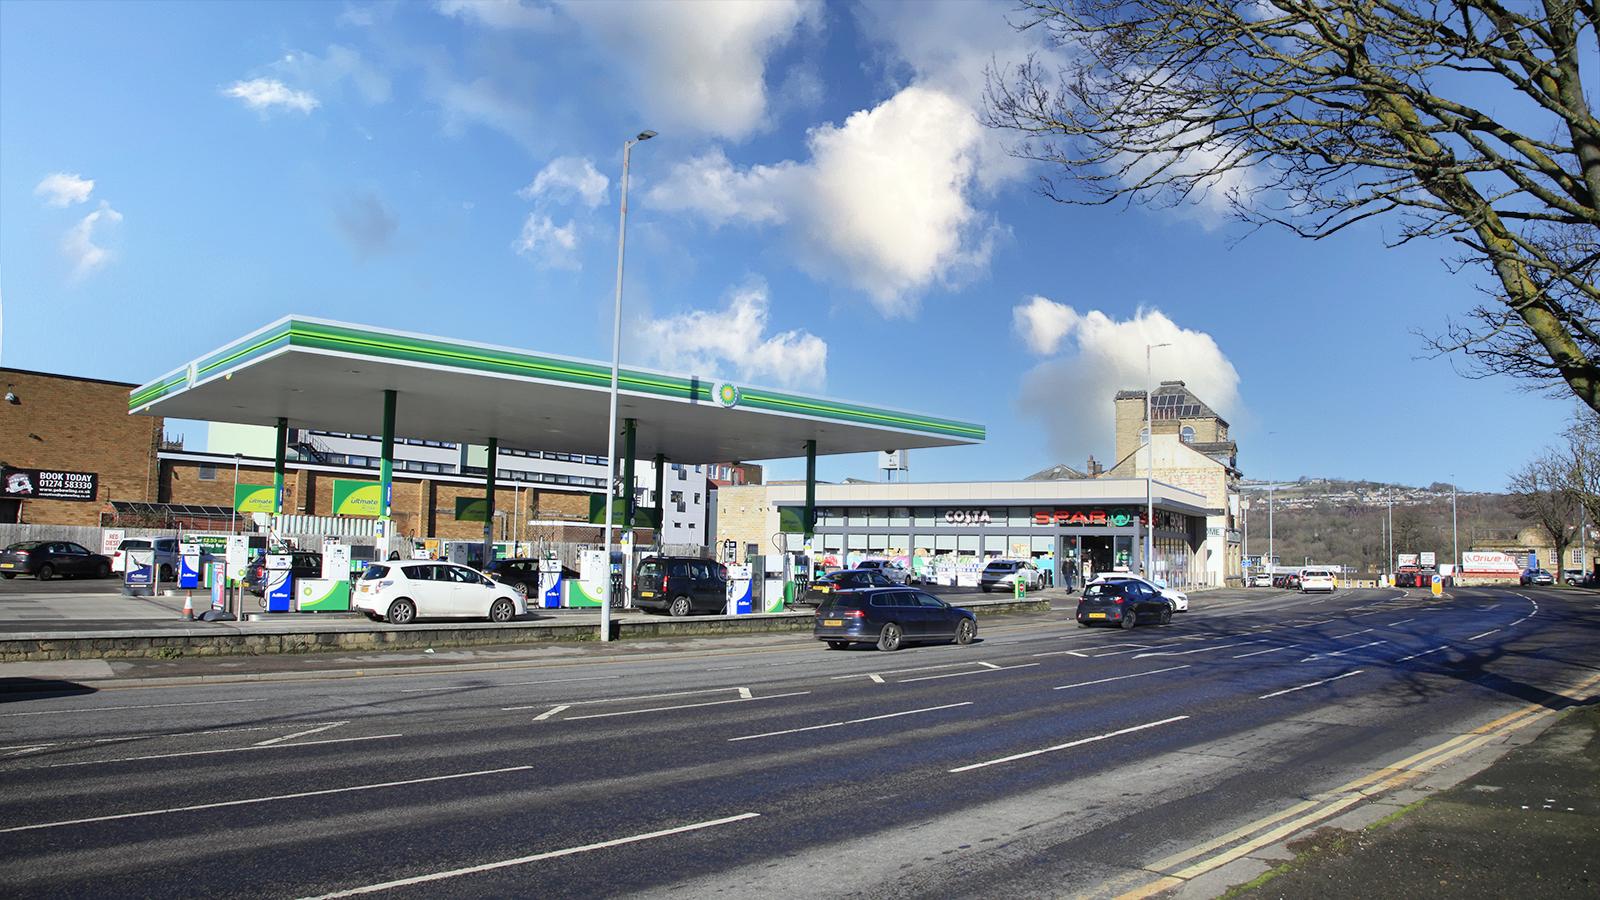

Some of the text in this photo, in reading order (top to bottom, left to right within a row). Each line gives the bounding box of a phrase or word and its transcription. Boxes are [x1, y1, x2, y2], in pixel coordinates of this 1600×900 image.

[40, 472, 92, 482] BOOK TODAY
[944, 510, 990, 522] COSTA
[1034, 511, 1106, 524] SPAR
